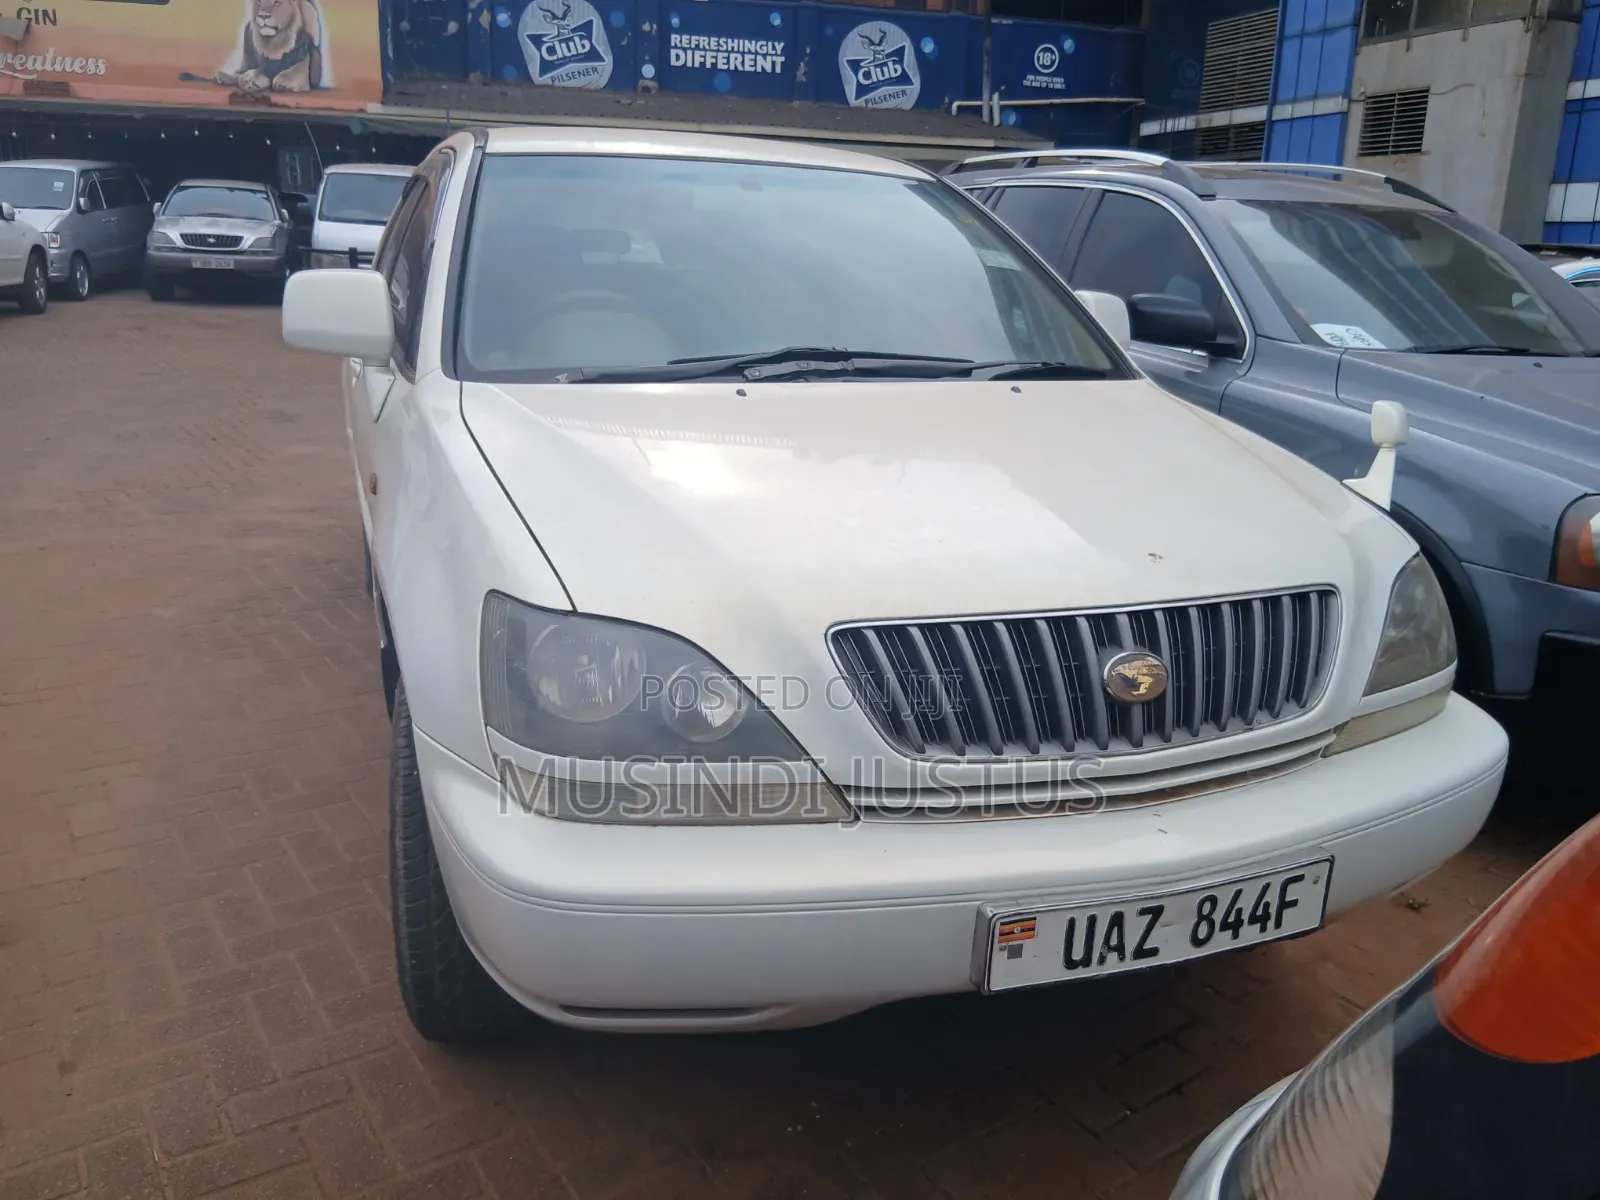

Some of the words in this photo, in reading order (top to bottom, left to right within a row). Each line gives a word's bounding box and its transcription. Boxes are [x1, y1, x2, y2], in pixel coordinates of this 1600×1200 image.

[16, 7, 58, 27] GIN
[541, 36, 591, 61] Club
[670, 34, 785, 55] REFRESHINGLY
[670, 48, 786, 74] DIFFERENT
[550, 66, 600, 84] PILSENER
[857, 61, 903, 85] Club
[864, 89, 908, 107] PILSENER
[1062, 904, 1165, 970] UAZ
[1189, 873, 1306, 949] 844F
